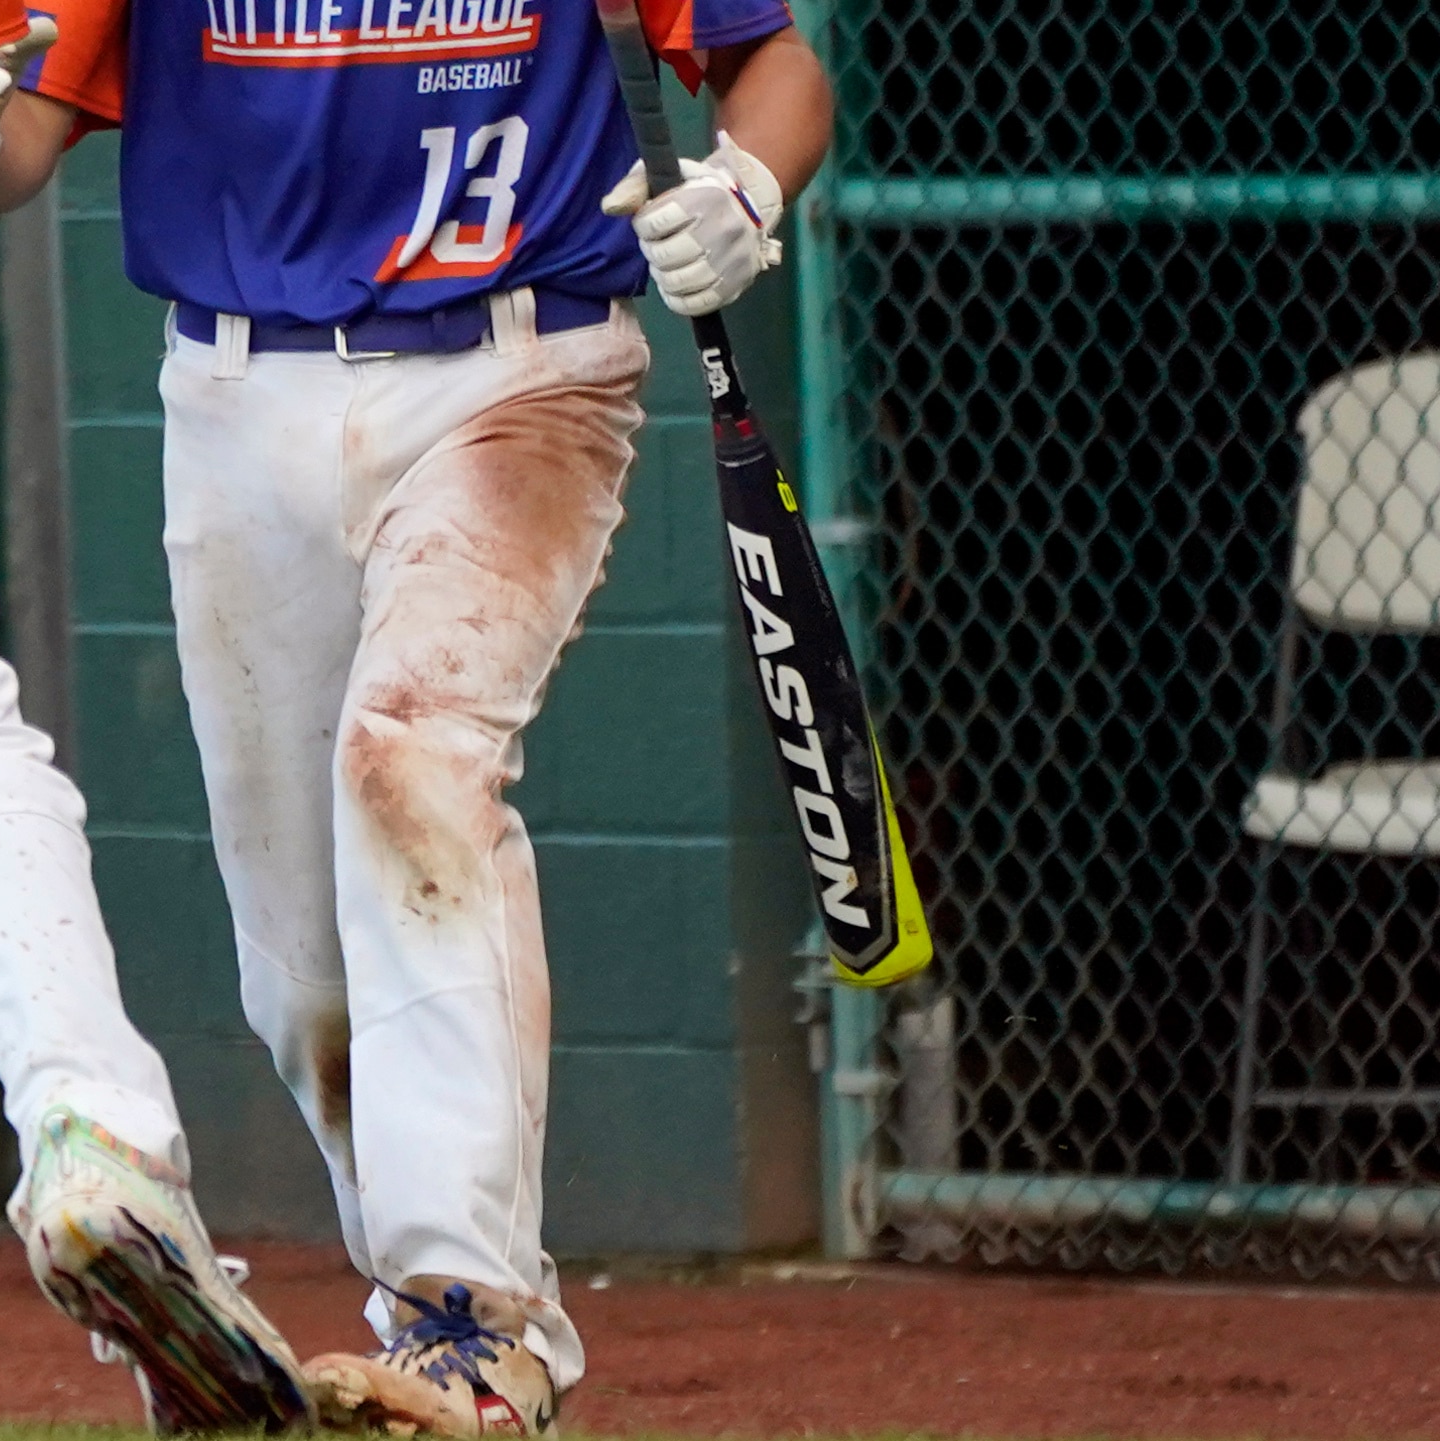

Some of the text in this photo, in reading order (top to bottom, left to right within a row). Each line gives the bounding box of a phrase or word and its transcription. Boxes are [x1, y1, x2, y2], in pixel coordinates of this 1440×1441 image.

[417, 58, 523, 94] BASEBALL
[396, 115, 530, 269] 13
[726, 520, 871, 930] EASTON
